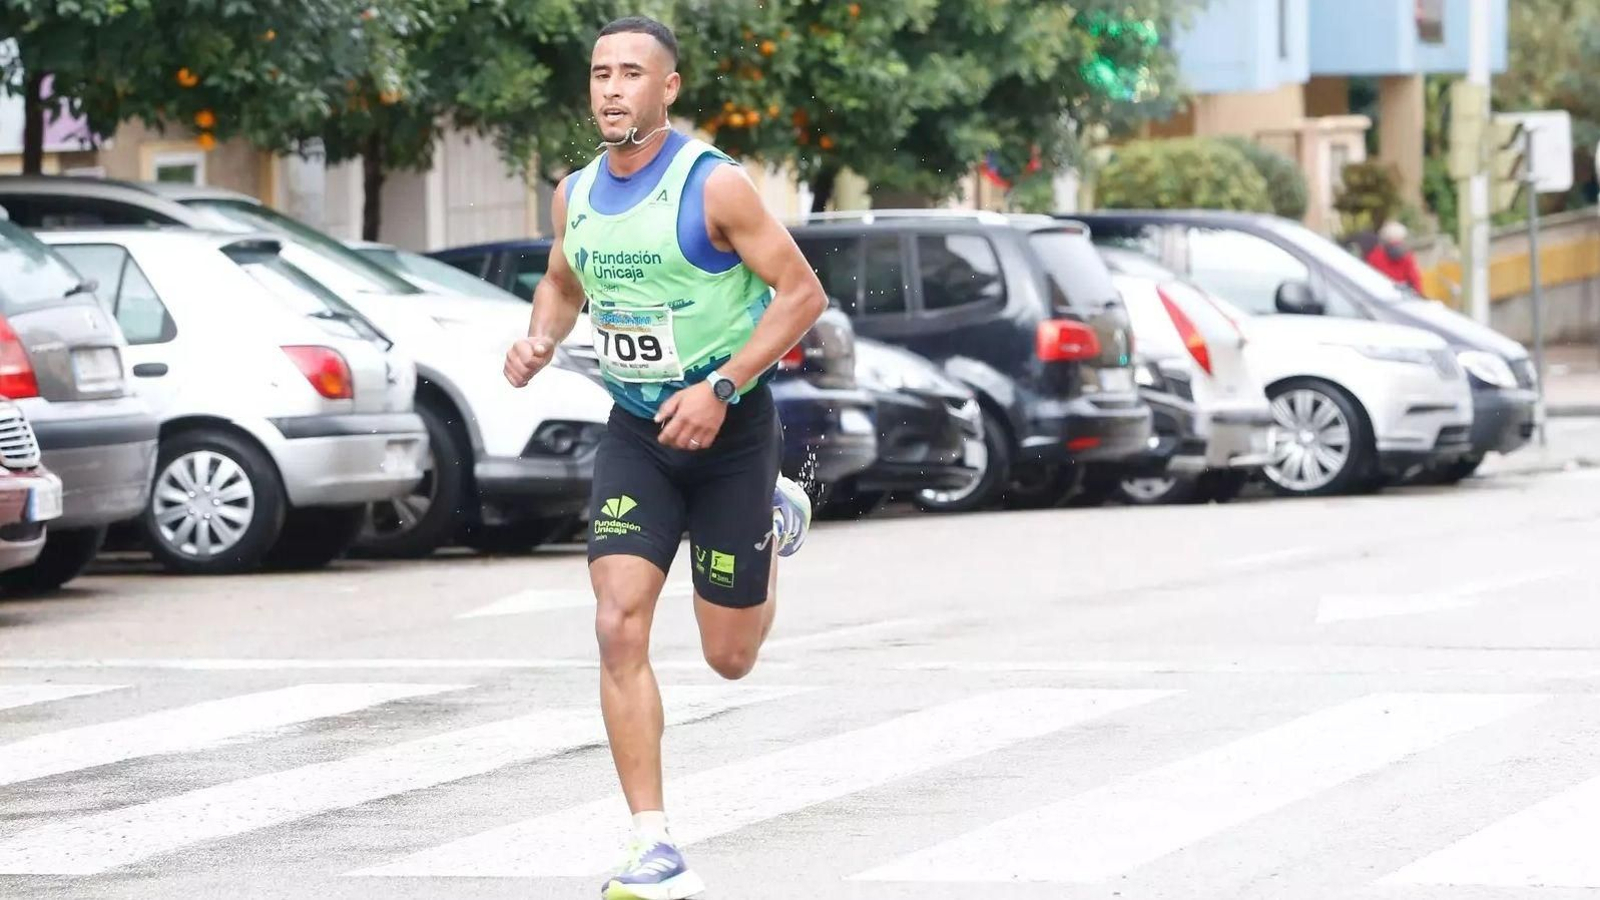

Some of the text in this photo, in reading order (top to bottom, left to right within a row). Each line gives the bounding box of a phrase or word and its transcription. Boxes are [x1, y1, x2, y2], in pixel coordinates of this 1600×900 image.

[592, 250, 662, 265] Fundación
[593, 265, 645, 282] Unicaja
[596, 327, 663, 362] 709
